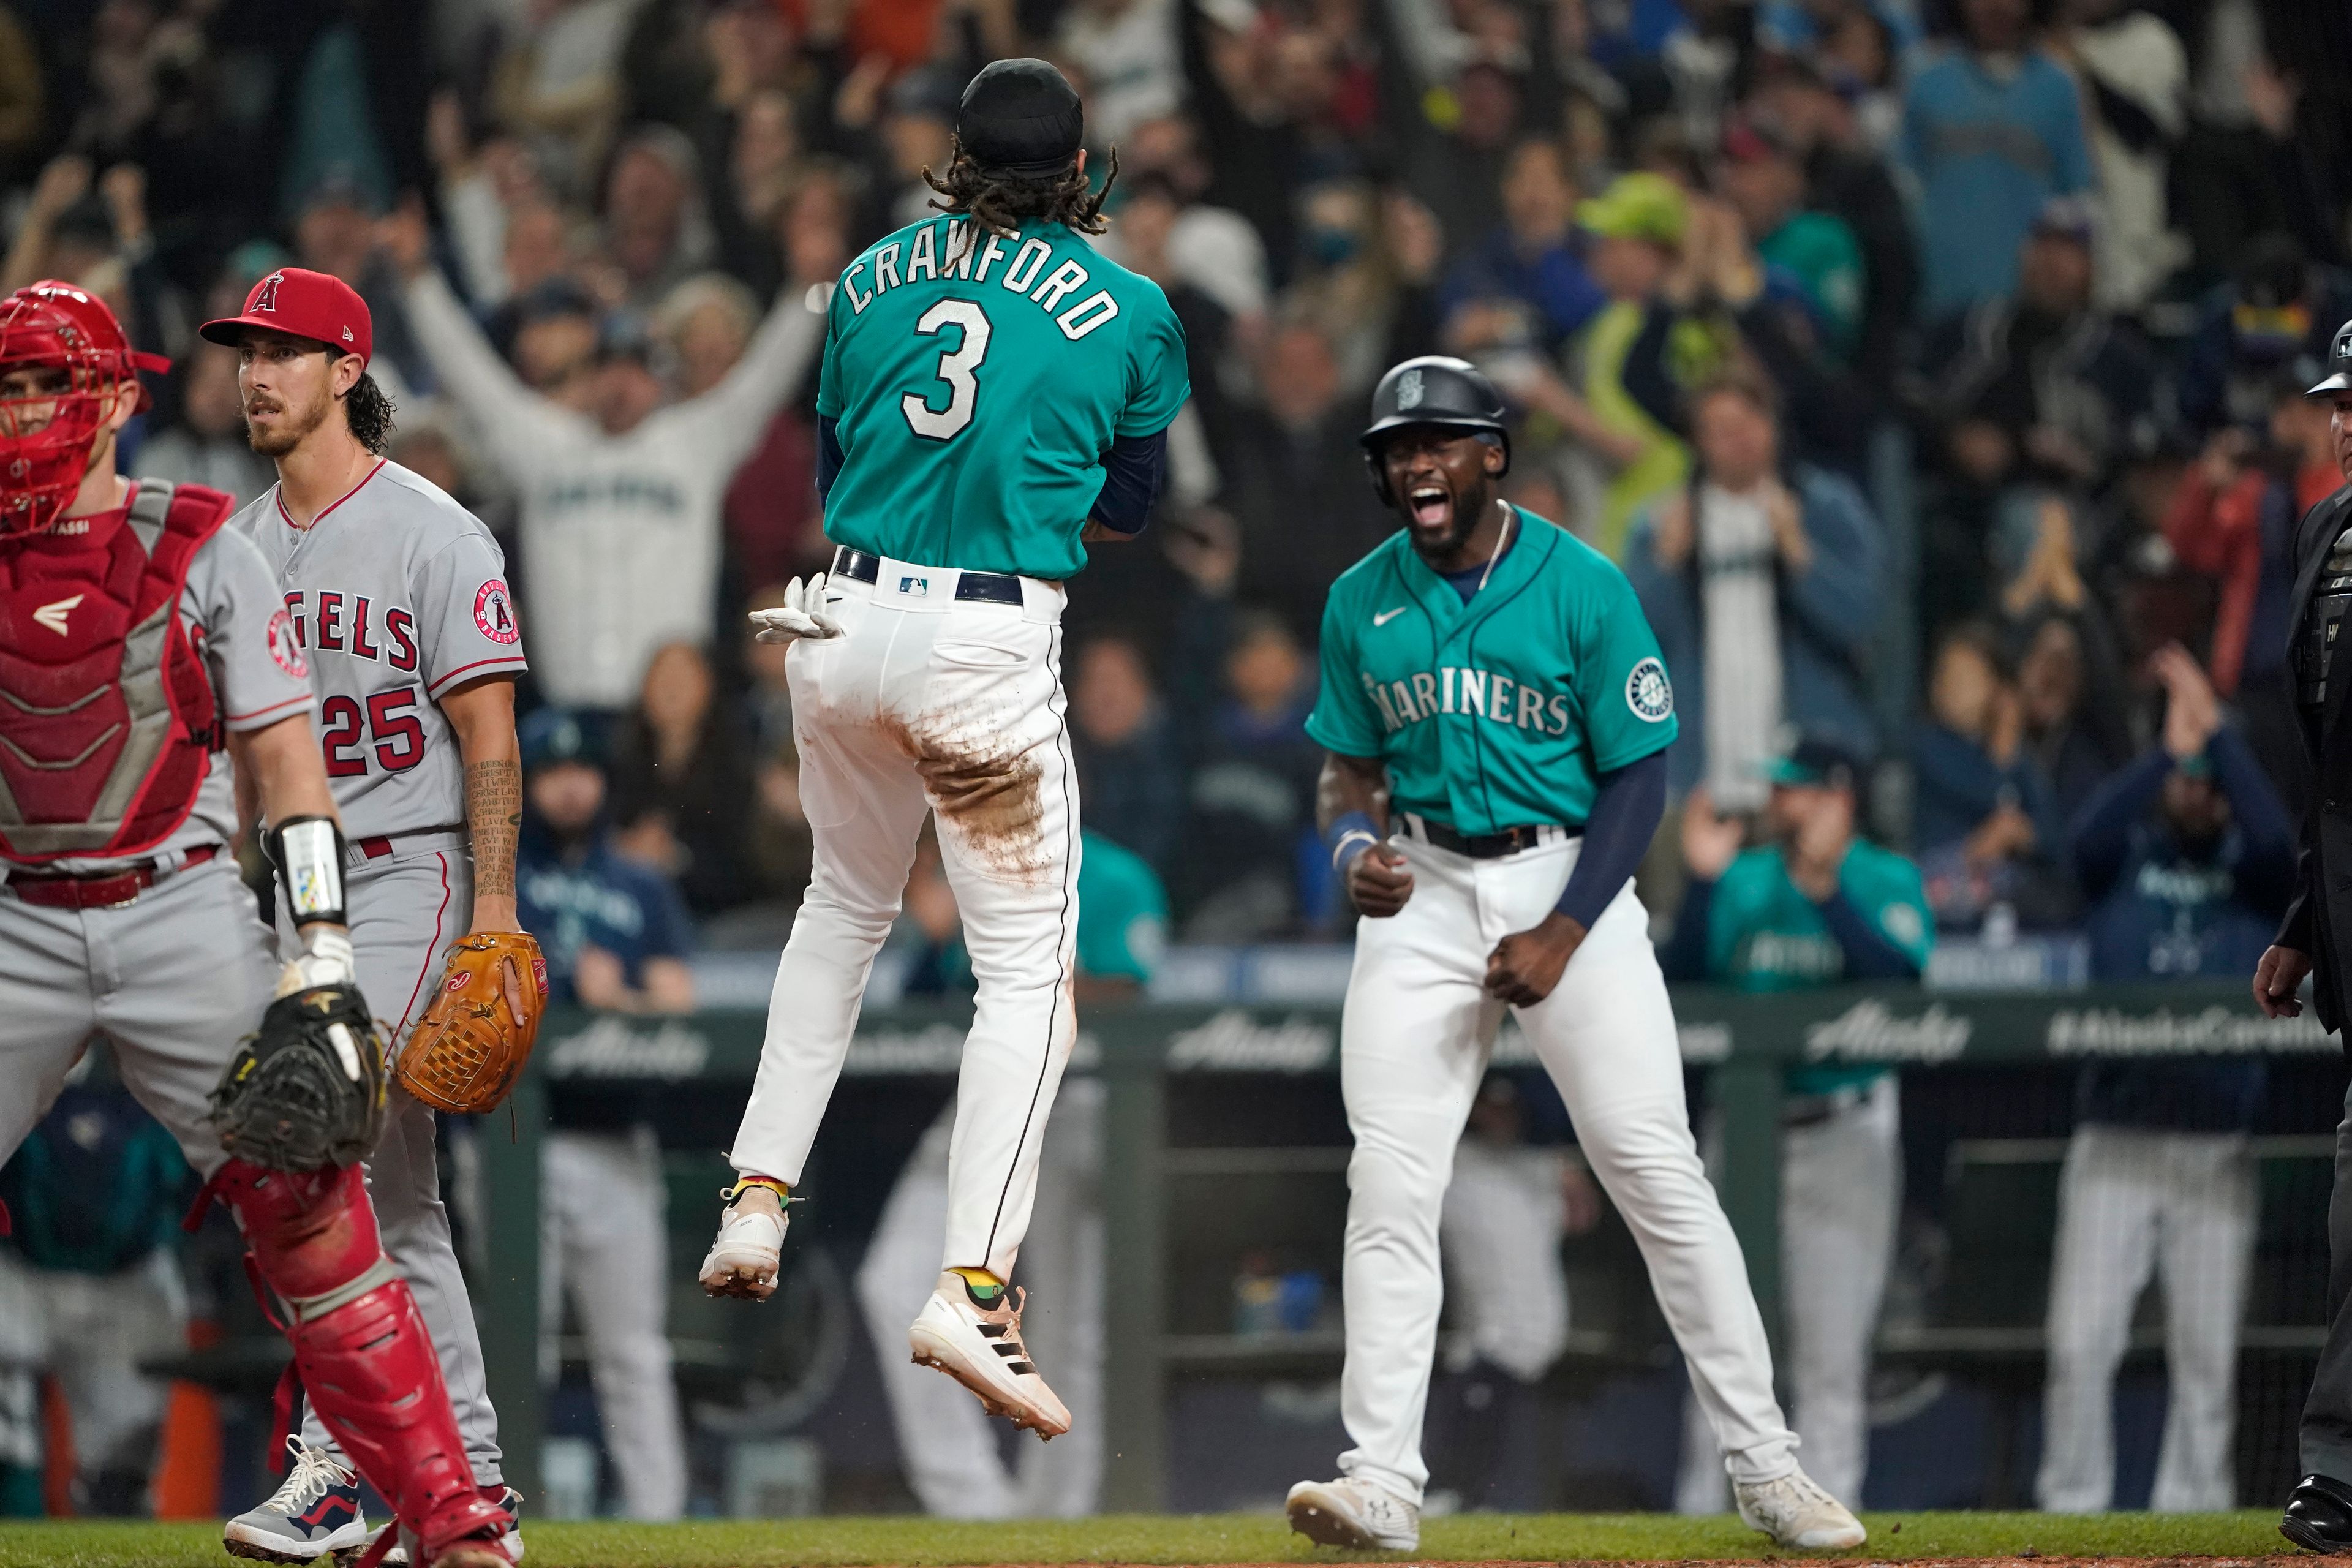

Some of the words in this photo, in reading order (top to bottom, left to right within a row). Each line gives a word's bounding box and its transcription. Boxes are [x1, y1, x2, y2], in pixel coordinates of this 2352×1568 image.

[843, 219, 1120, 342] CRAWFORD
[900, 295, 994, 443] 3
[322, 687, 428, 778] 25
[1362, 666, 1569, 736] MARINERS
